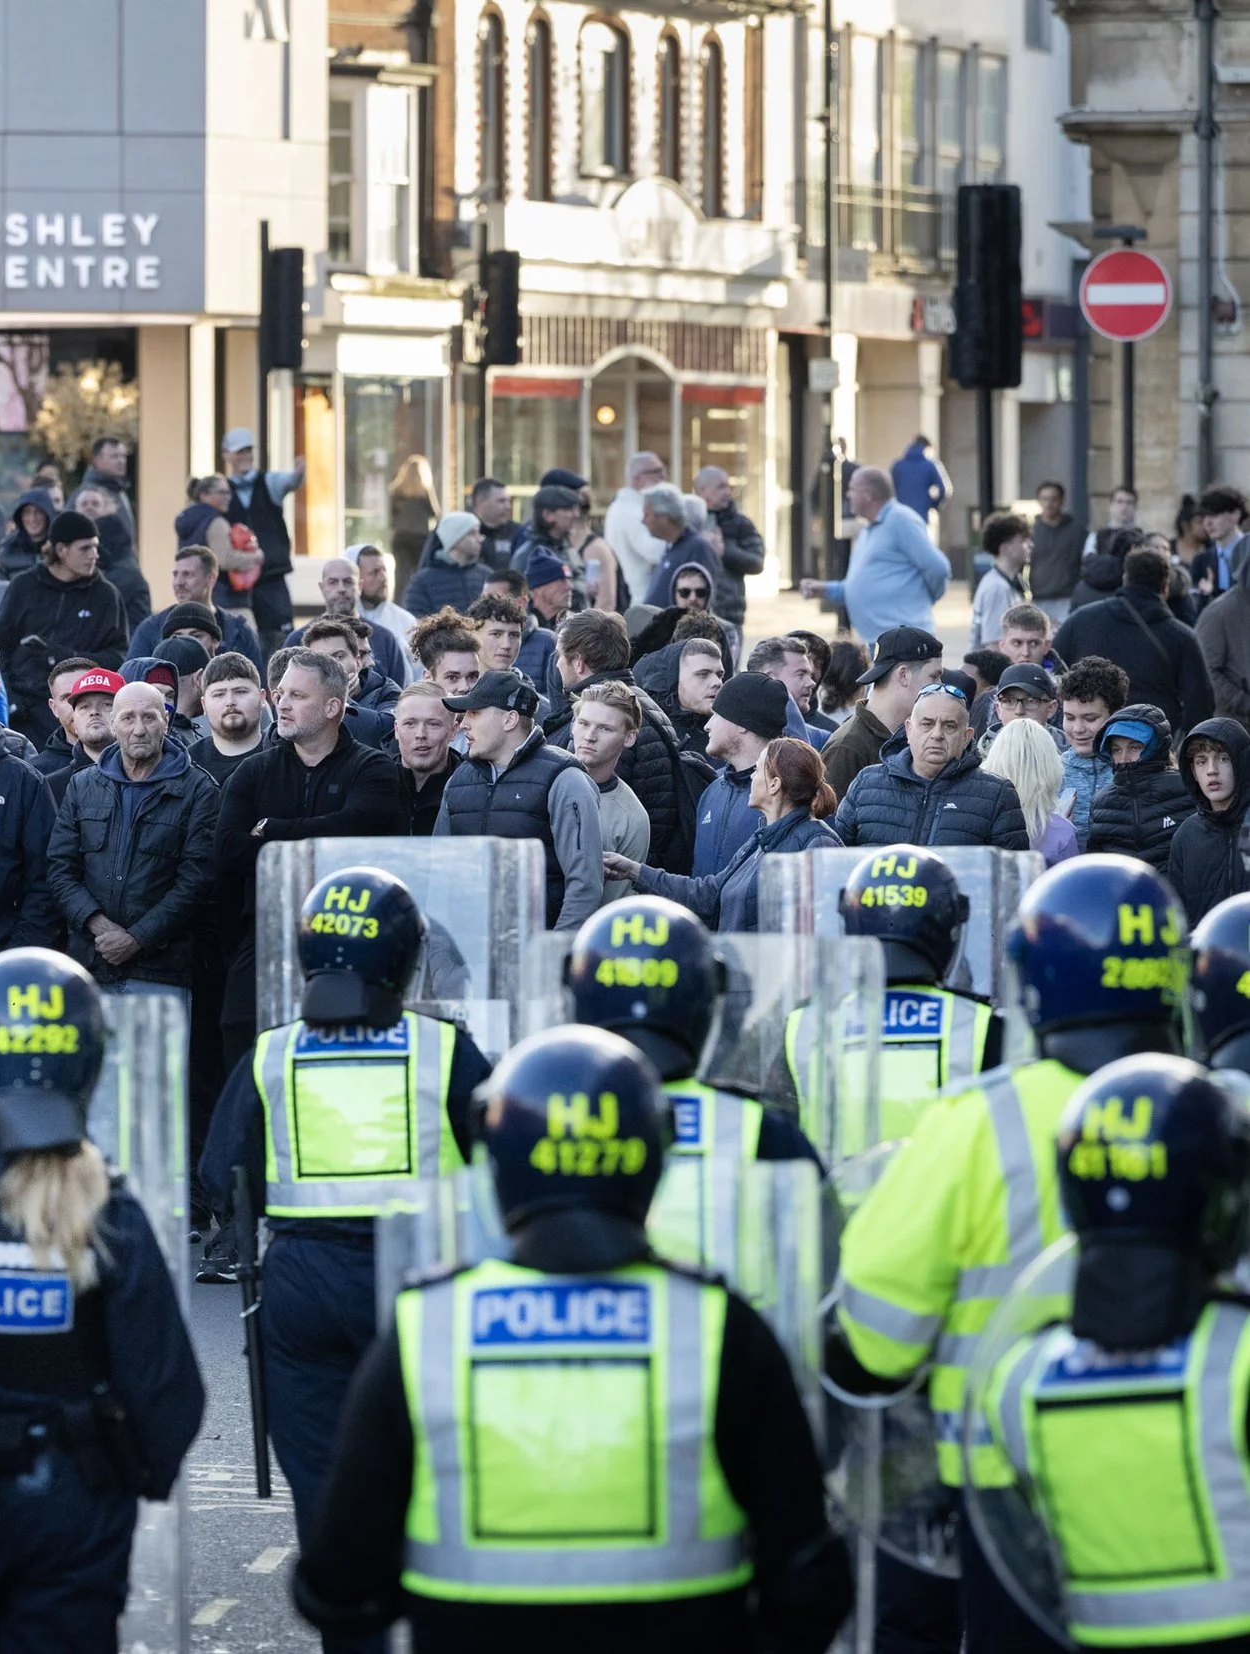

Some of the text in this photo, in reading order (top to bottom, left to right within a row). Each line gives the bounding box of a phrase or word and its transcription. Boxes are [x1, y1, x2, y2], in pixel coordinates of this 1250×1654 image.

[79, 675, 111, 689] MEGA
[871, 854, 918, 878] HJ
[323, 886, 371, 913] HJ
[861, 885, 928, 908] 41539
[310, 913, 379, 938] 42073
[611, 913, 669, 948] HJ
[1118, 904, 1181, 945] HJ
[7, 984, 64, 1019] HJ
[547, 1092, 619, 1139] HJ
[1082, 1096, 1154, 1141] HJ
[476, 1288, 646, 1339] POLICE
